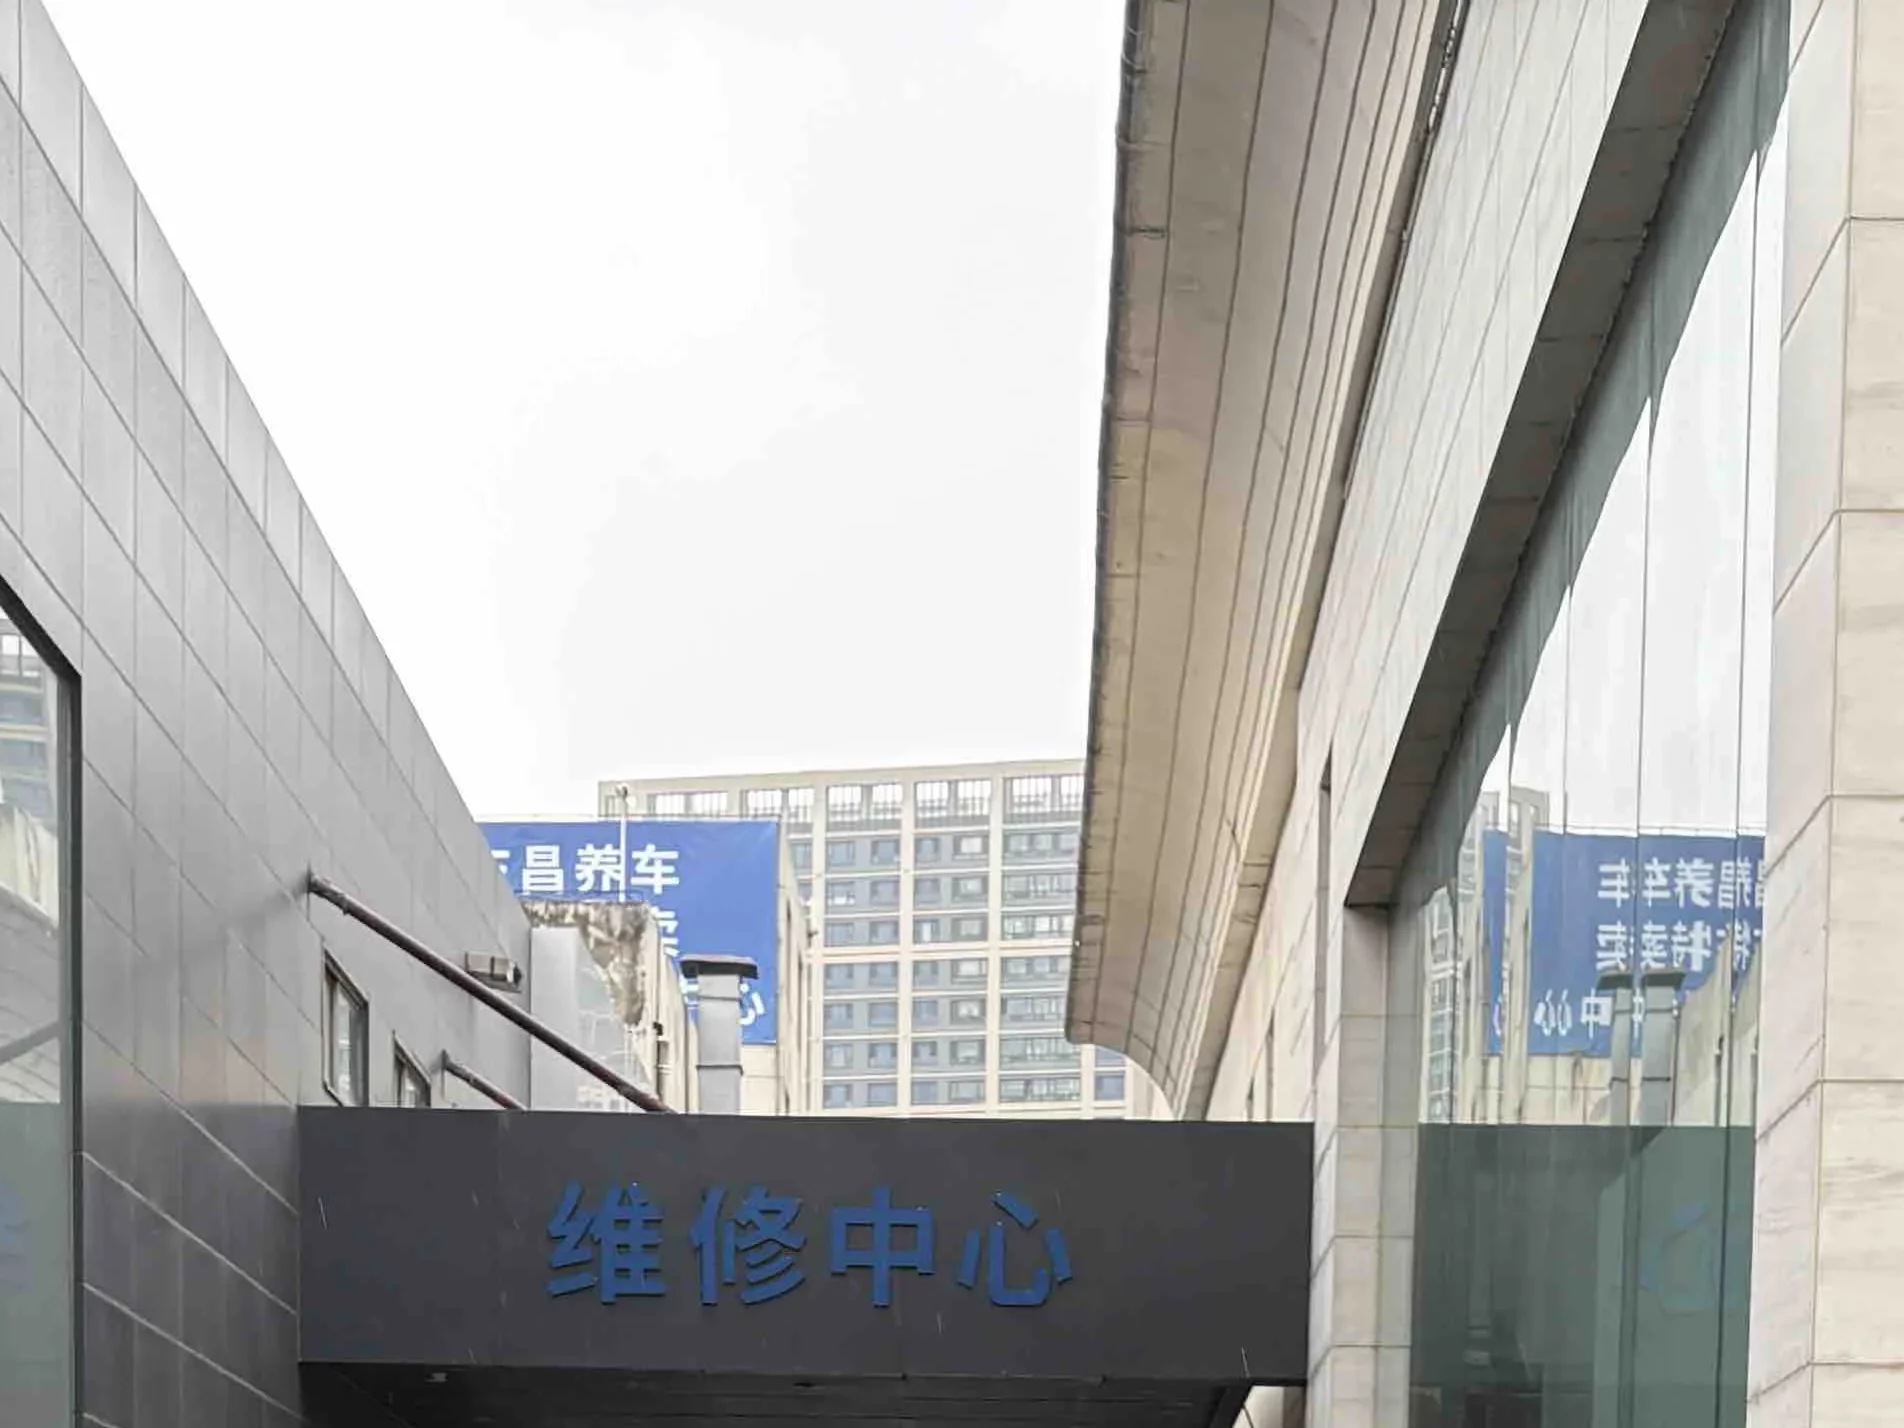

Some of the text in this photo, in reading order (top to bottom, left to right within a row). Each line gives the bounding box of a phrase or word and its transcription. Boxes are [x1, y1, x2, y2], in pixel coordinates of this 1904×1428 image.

[491, 843, 680, 895] 昌养车
[546, 1181, 1072, 1308] 维修中心
